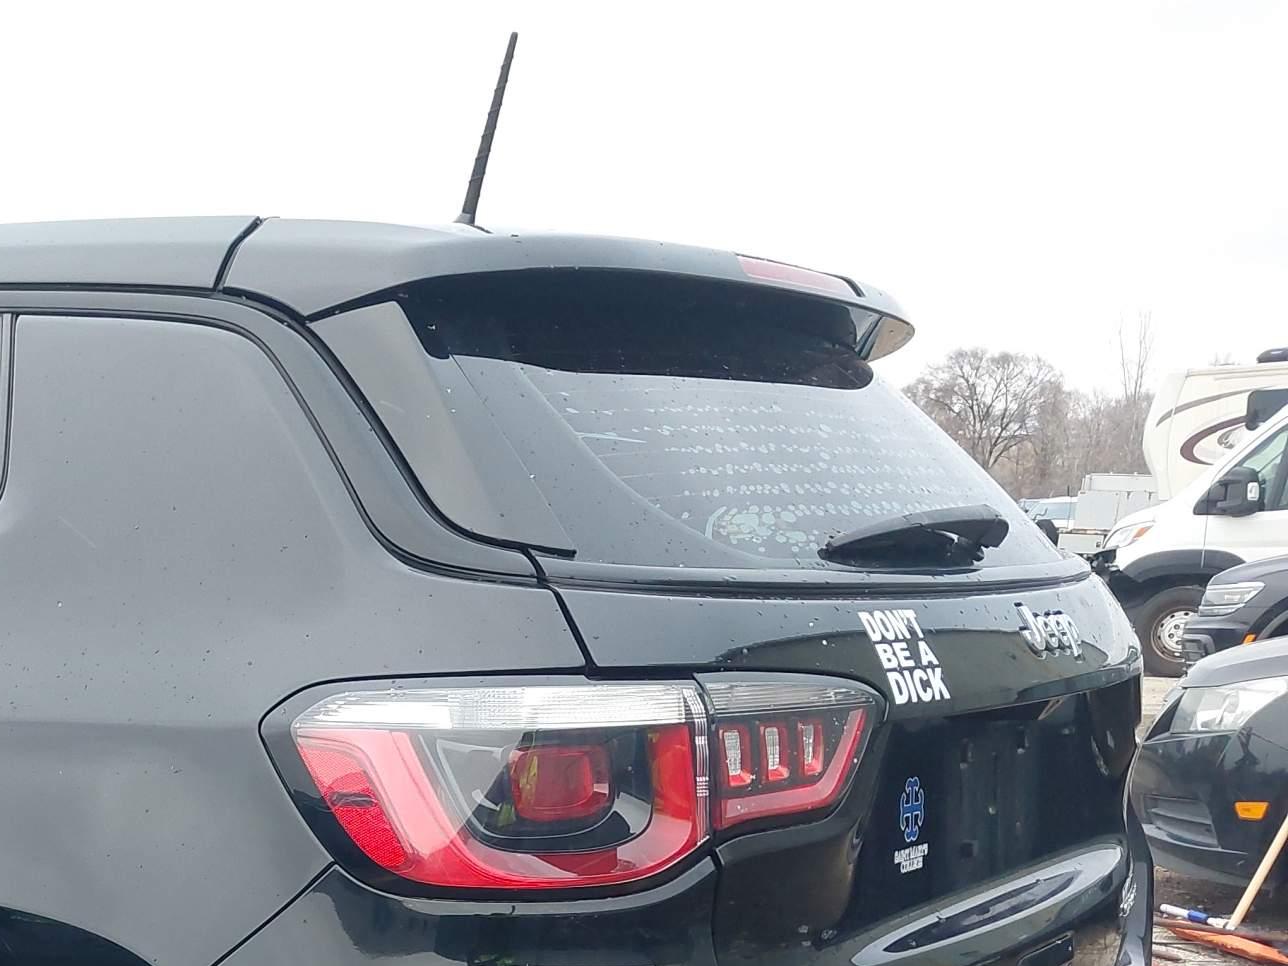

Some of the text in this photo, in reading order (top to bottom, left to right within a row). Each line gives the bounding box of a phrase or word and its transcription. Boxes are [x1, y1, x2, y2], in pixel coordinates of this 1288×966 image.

[858, 608, 925, 642] DON'T
[1013, 602, 1083, 659] Jeep
[874, 640, 940, 670] BE A
[886, 667, 951, 704] DICK
